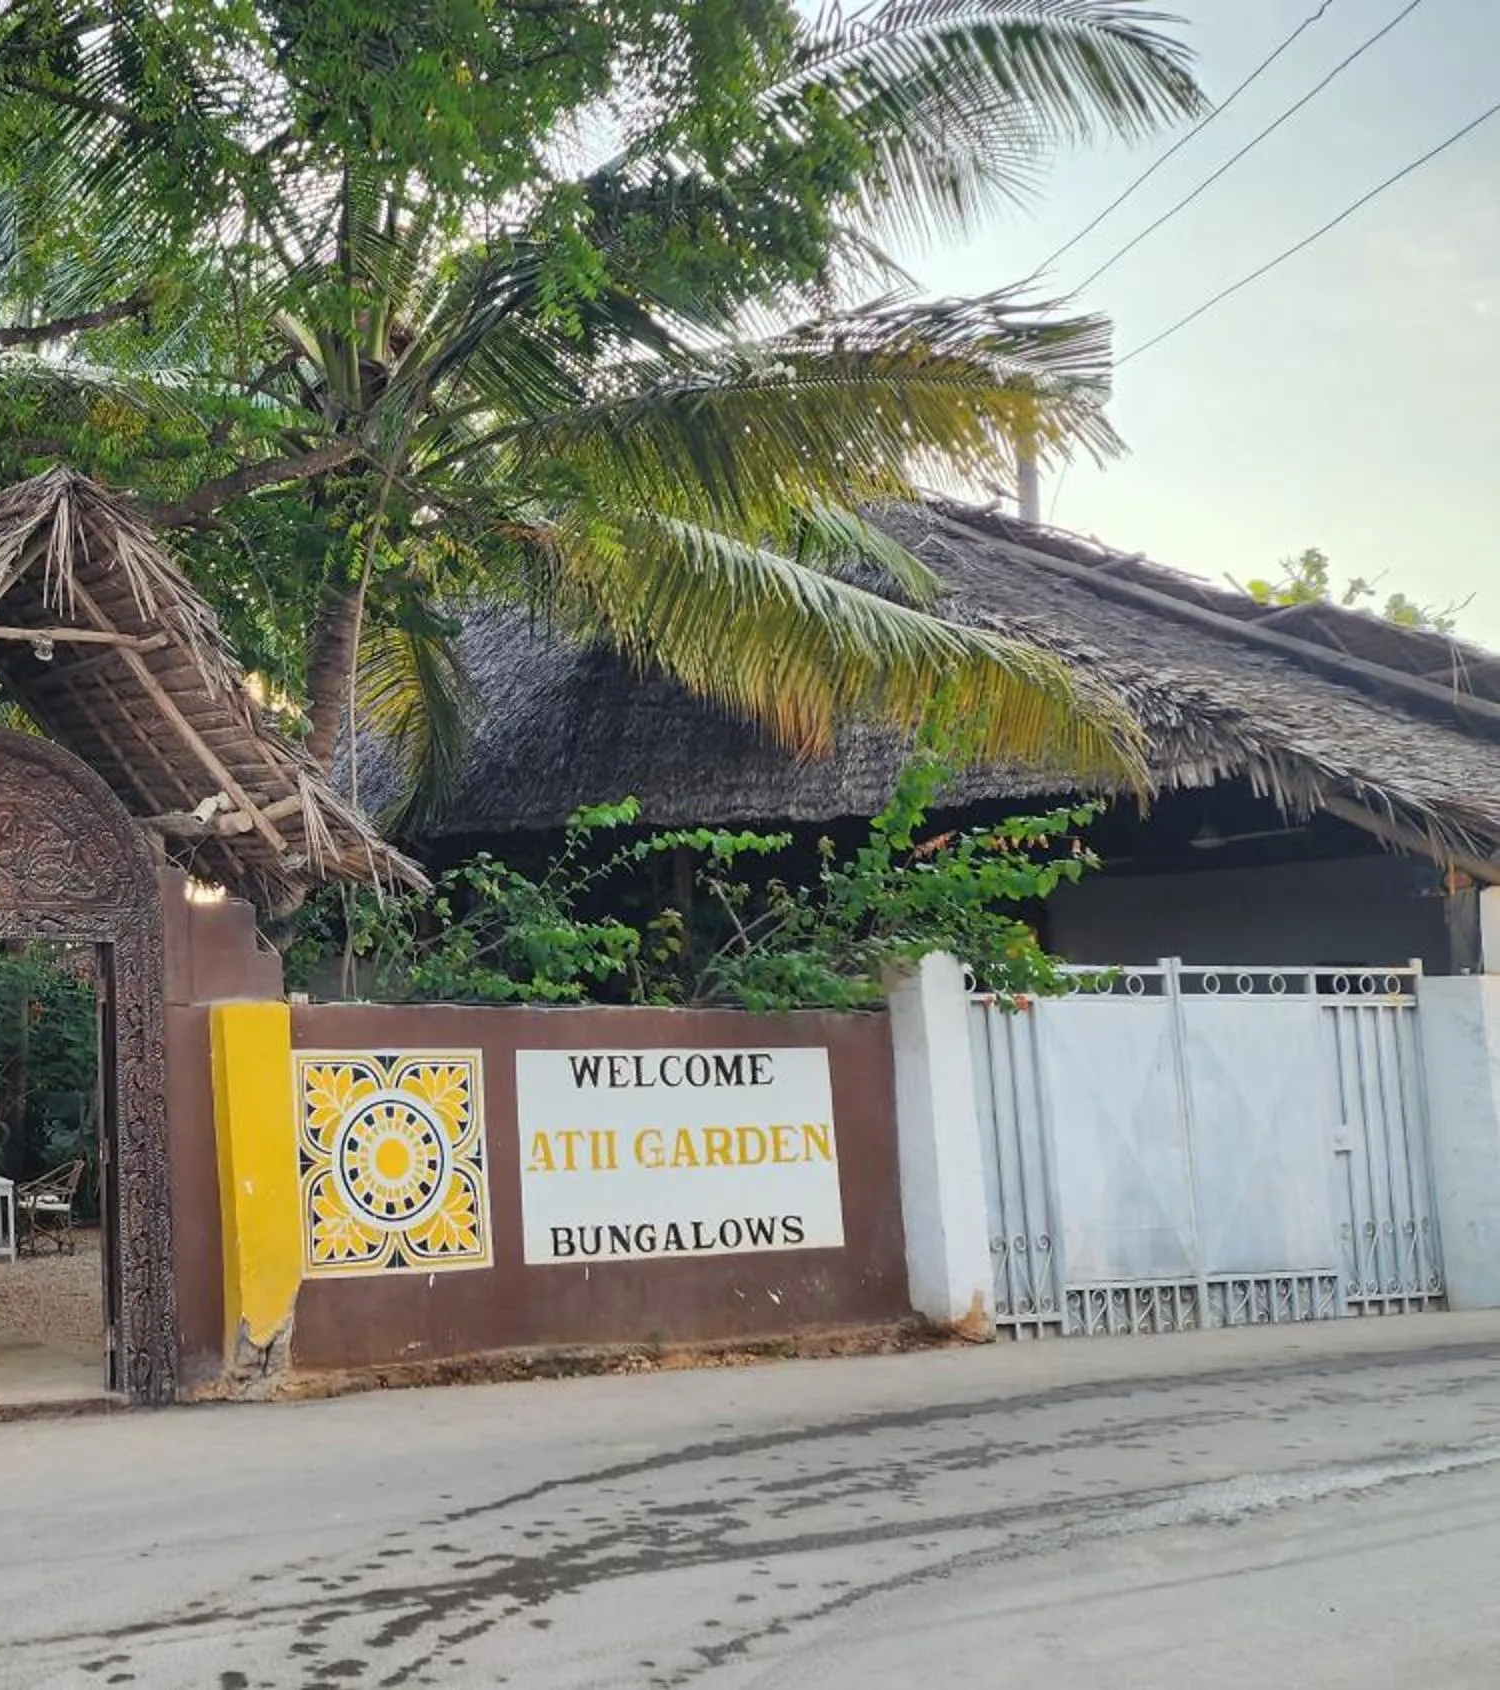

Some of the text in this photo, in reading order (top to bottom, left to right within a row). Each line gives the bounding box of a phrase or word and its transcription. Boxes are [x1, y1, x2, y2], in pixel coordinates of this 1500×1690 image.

[568, 1053, 775, 1088] WELCOME
[526, 1122, 834, 1172] ATII GARDEN
[550, 1215, 805, 1257] BUNGALOWS
